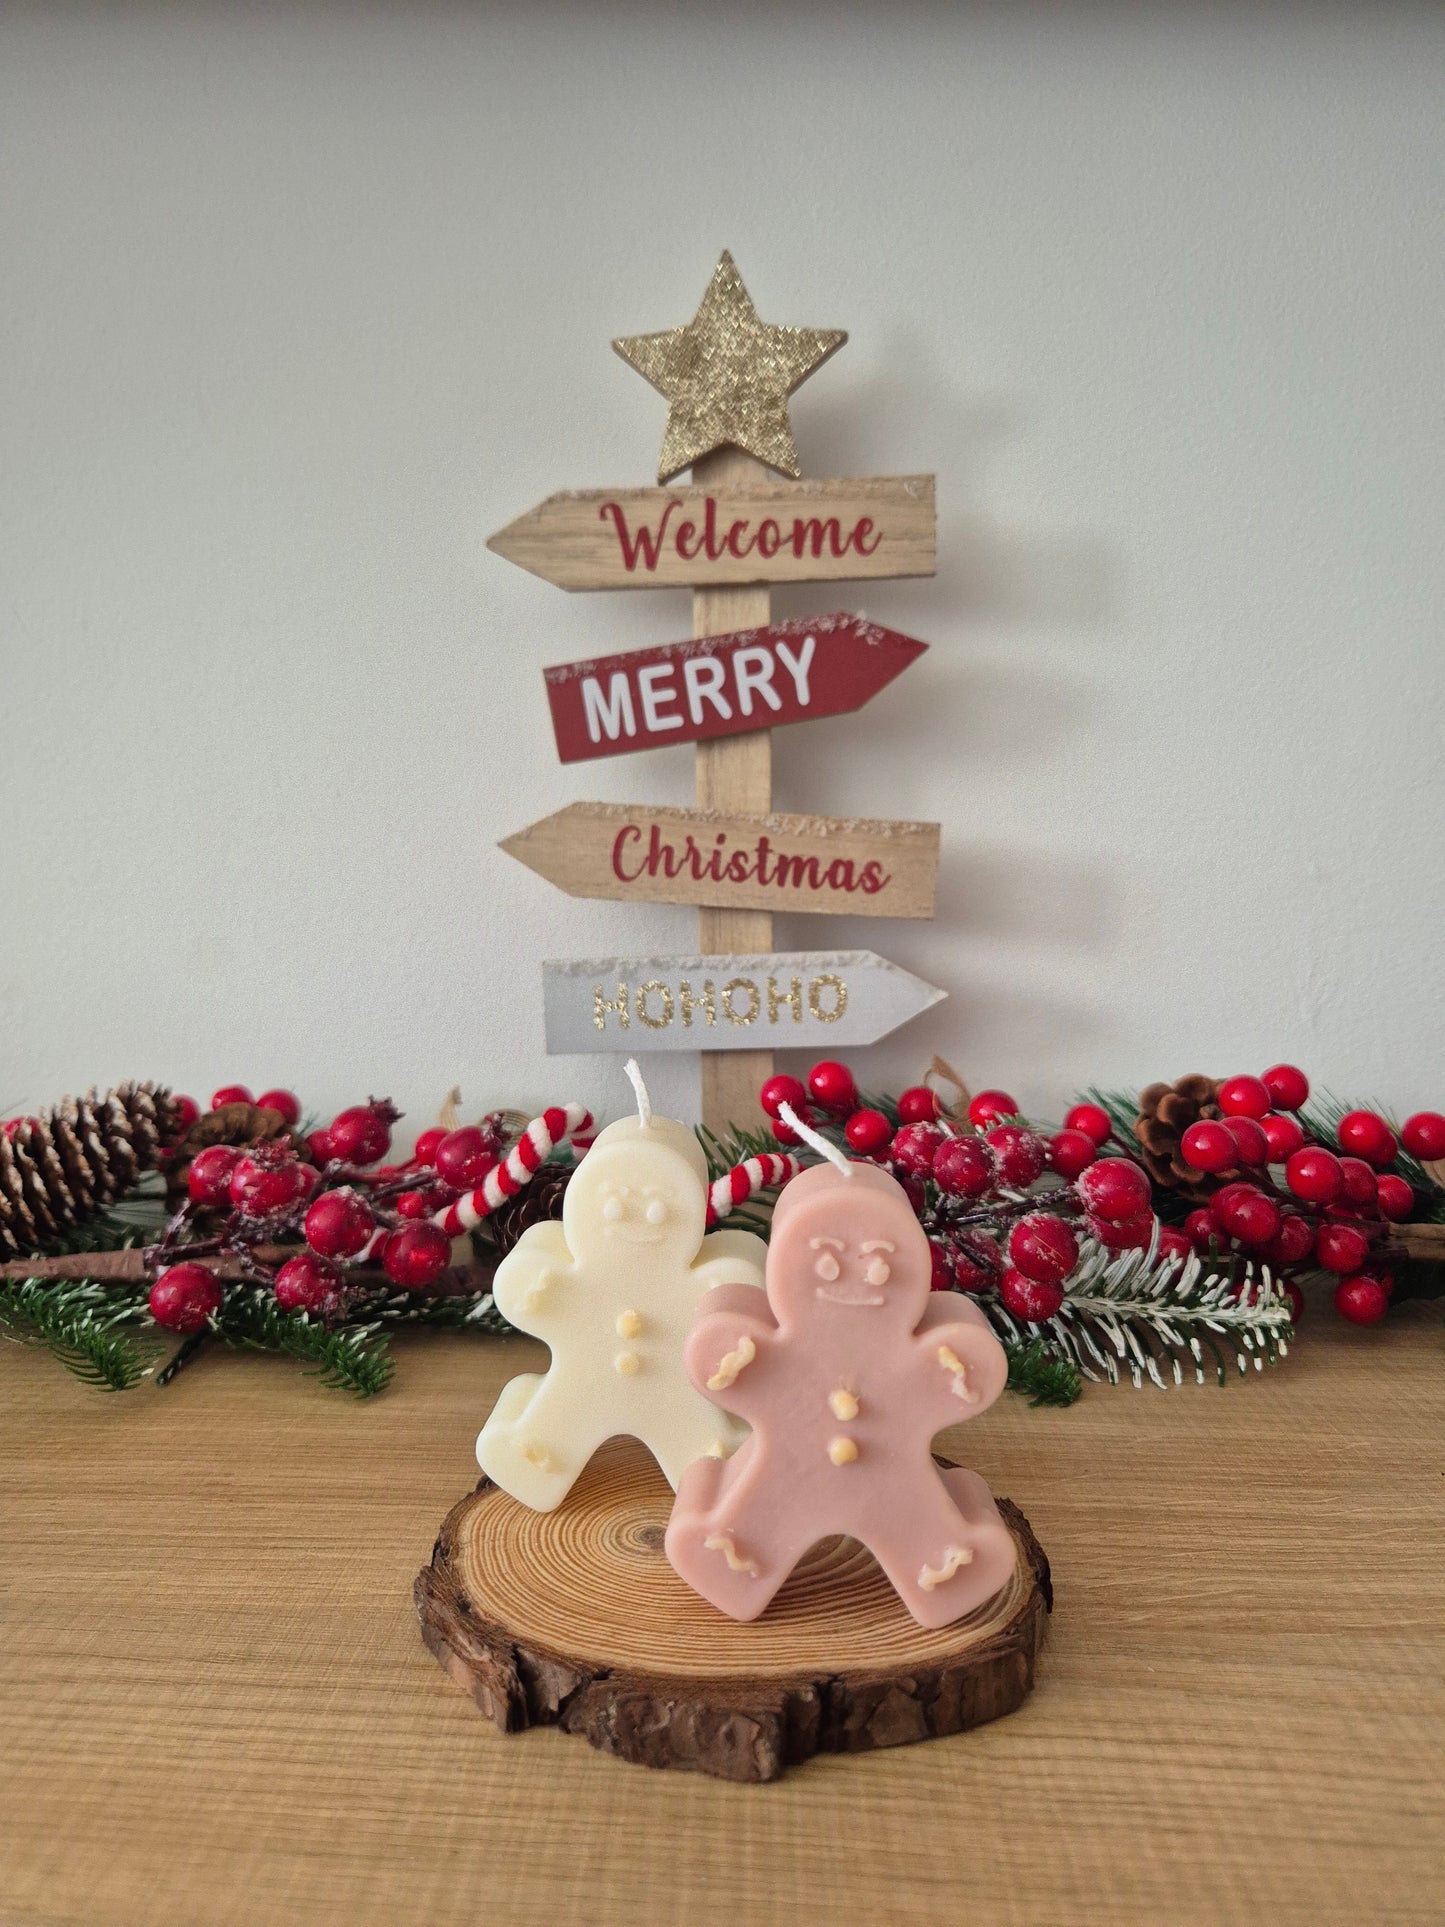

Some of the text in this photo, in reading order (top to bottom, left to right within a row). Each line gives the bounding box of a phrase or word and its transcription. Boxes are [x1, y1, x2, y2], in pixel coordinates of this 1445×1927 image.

[599, 496, 884, 572] Welcome
[580, 635, 816, 744] MERRY
[611, 824, 892, 895] Christmas
[592, 973, 849, 1031] HOHOHO
